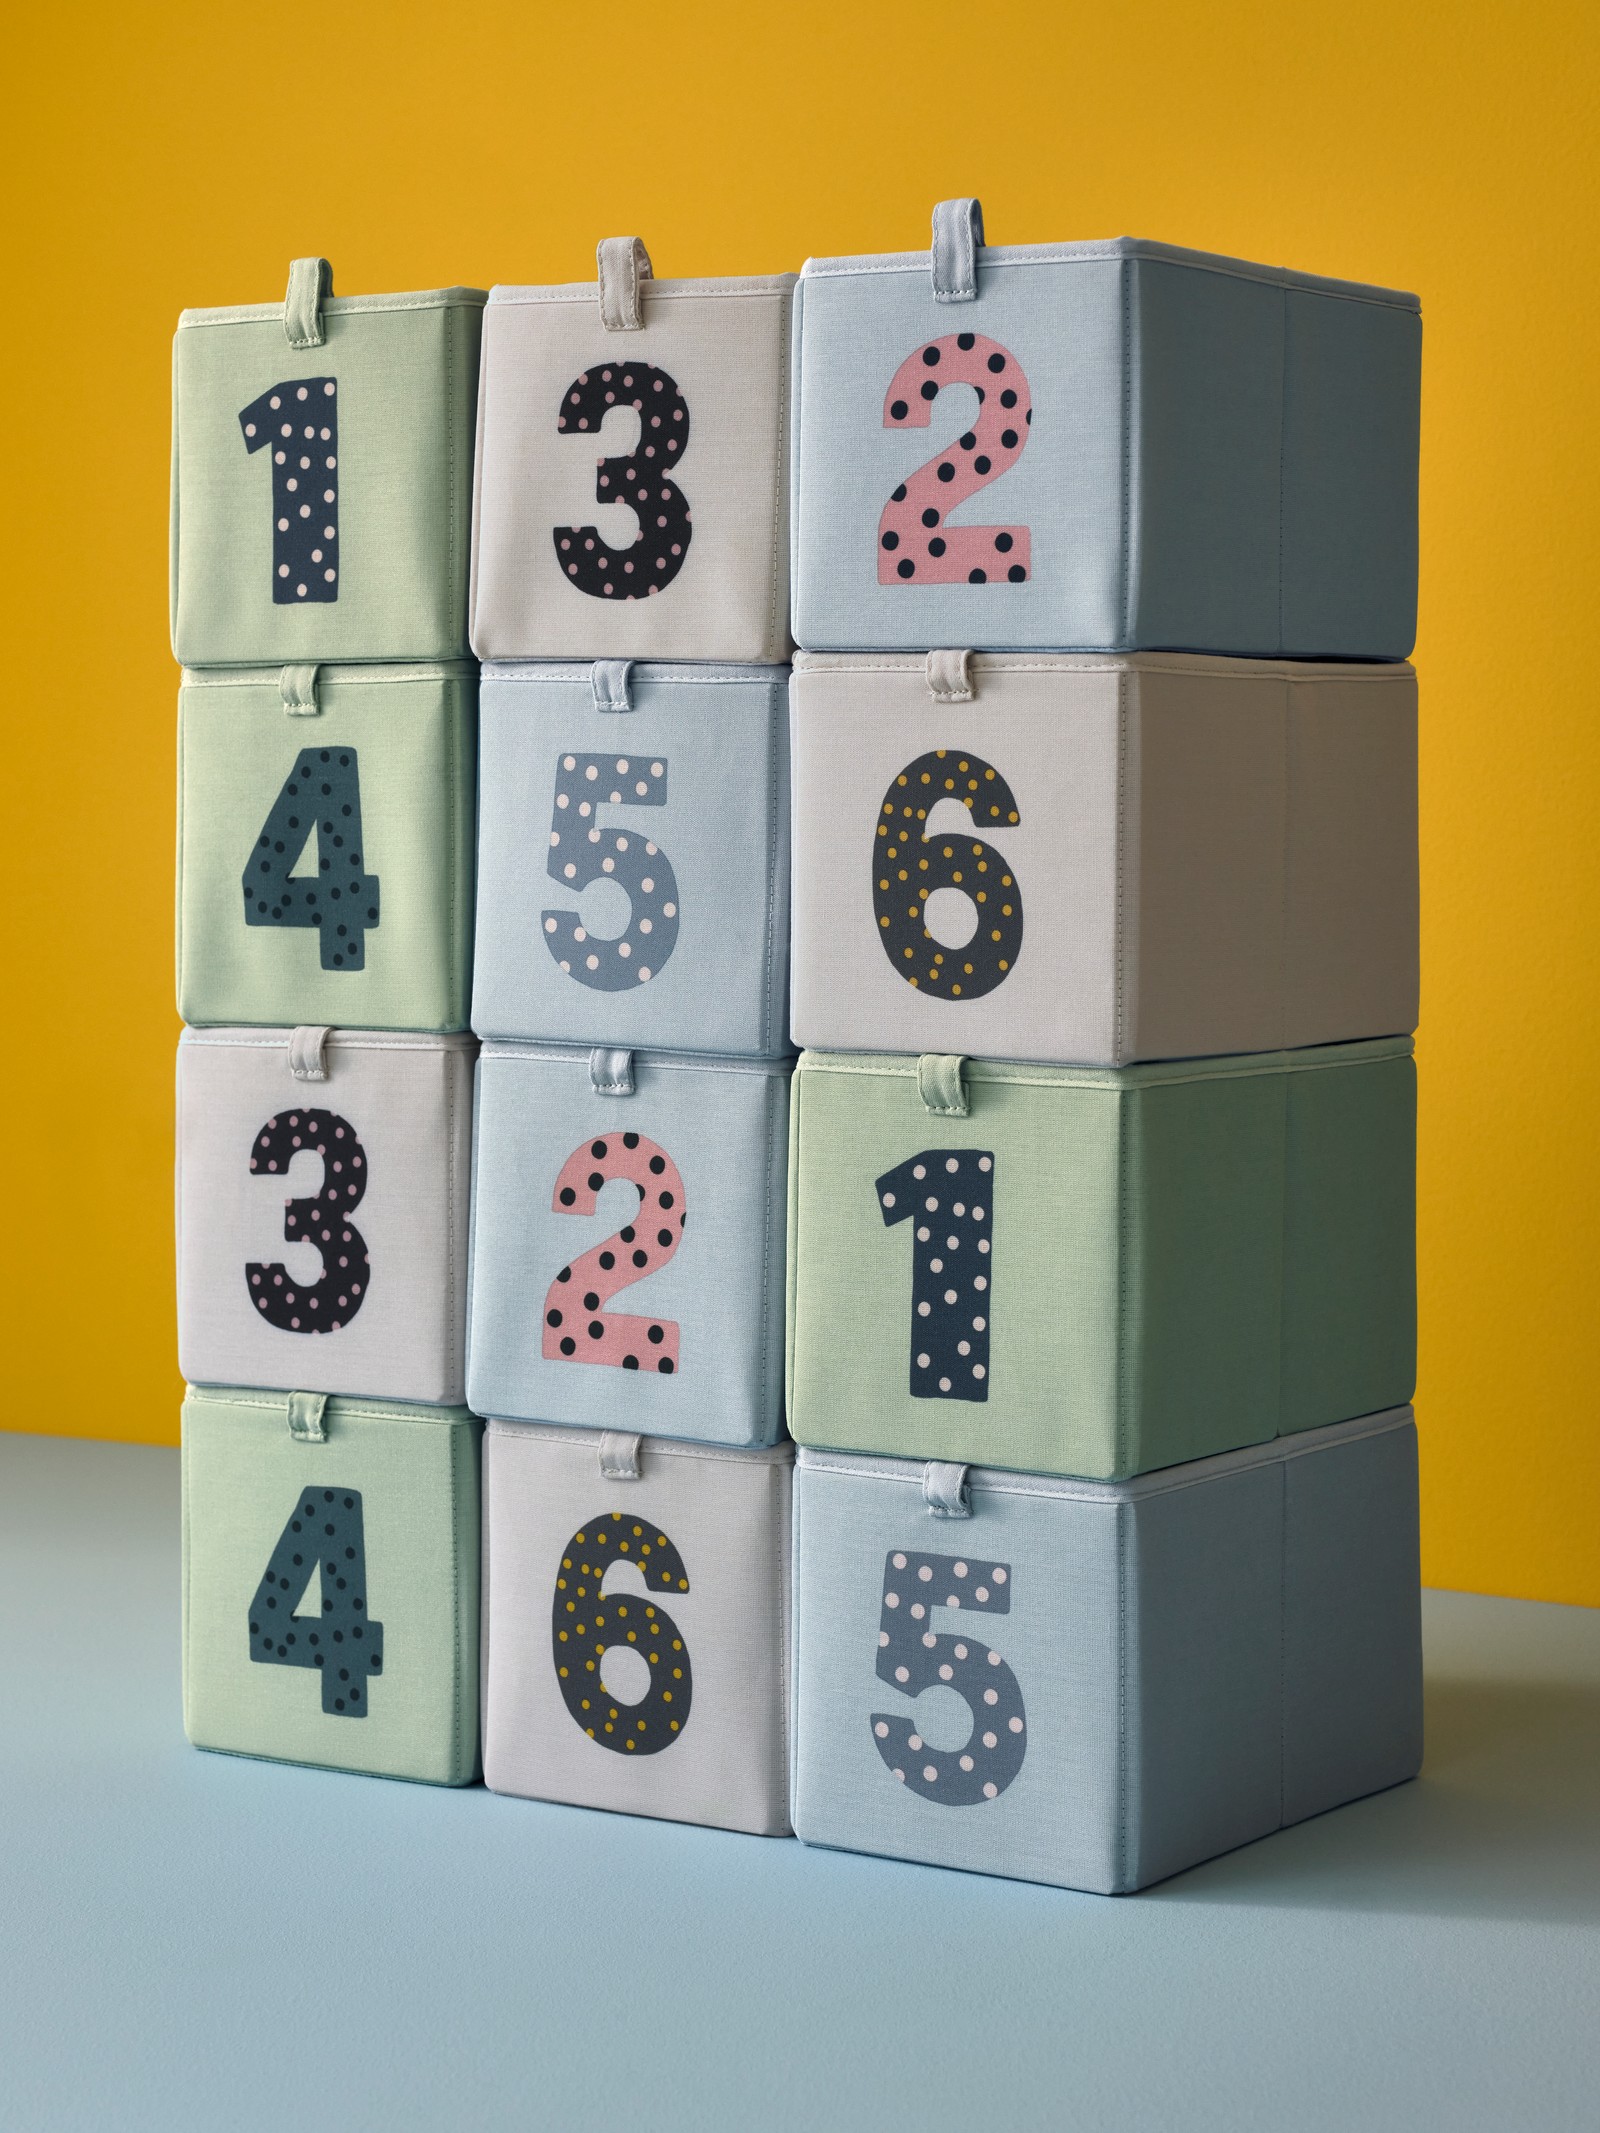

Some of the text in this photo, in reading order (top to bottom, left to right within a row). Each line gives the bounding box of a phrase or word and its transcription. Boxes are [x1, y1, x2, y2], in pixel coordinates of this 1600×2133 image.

[239, 377, 337, 604] 1
[553, 362, 692, 600] 3
[878, 333, 1032, 585] 2
[243, 747, 378, 971] 4
[541, 754, 678, 990] 5
[873, 750, 1021, 999] 6
[246, 1107, 369, 1334] 3
[543, 1132, 686, 1373] 2
[875, 1150, 994, 1401] 1
[249, 1486, 383, 1717] 4
[552, 1513, 691, 1755] 6
[871, 1551, 1026, 1805] 5
